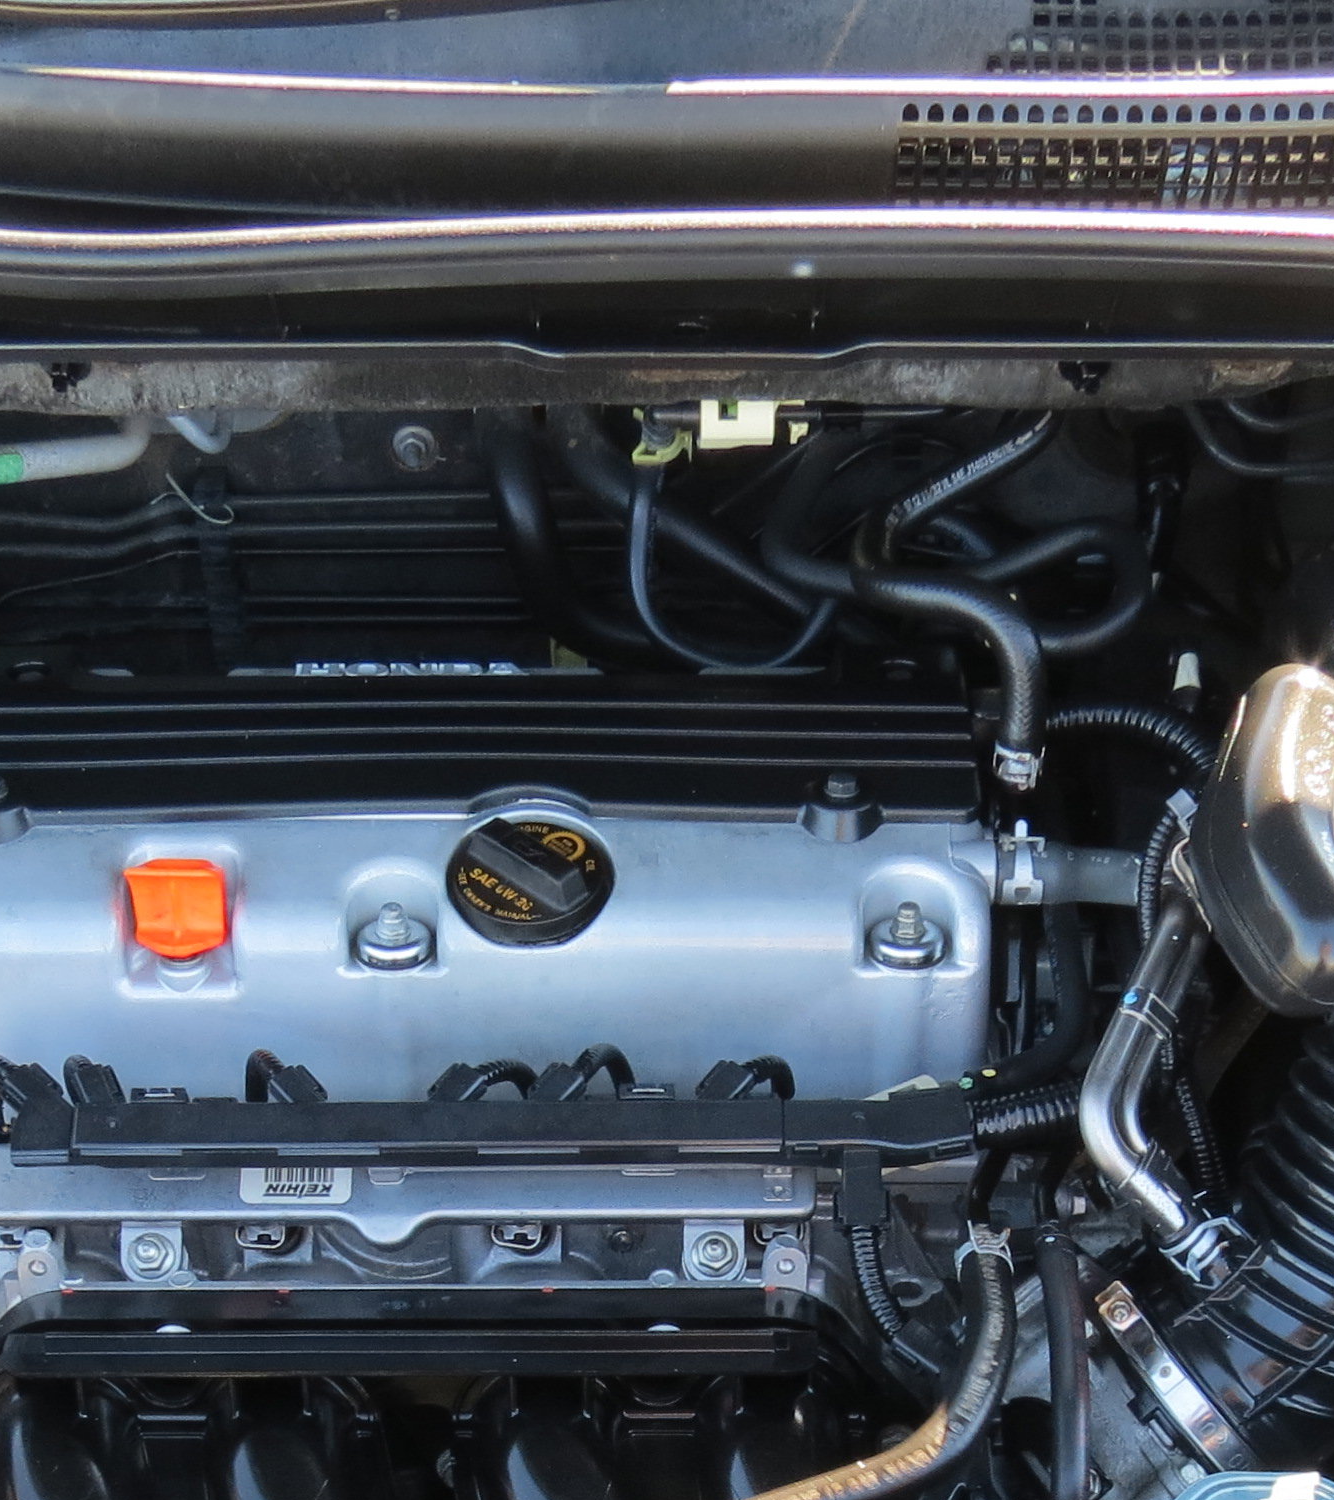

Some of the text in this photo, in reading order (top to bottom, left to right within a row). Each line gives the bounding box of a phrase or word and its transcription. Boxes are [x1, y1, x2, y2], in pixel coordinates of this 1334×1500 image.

[294, 661, 530, 677] HONDA
[468, 867, 496, 890] SAE
[265, 1183, 333, 1199] KEIHIN
